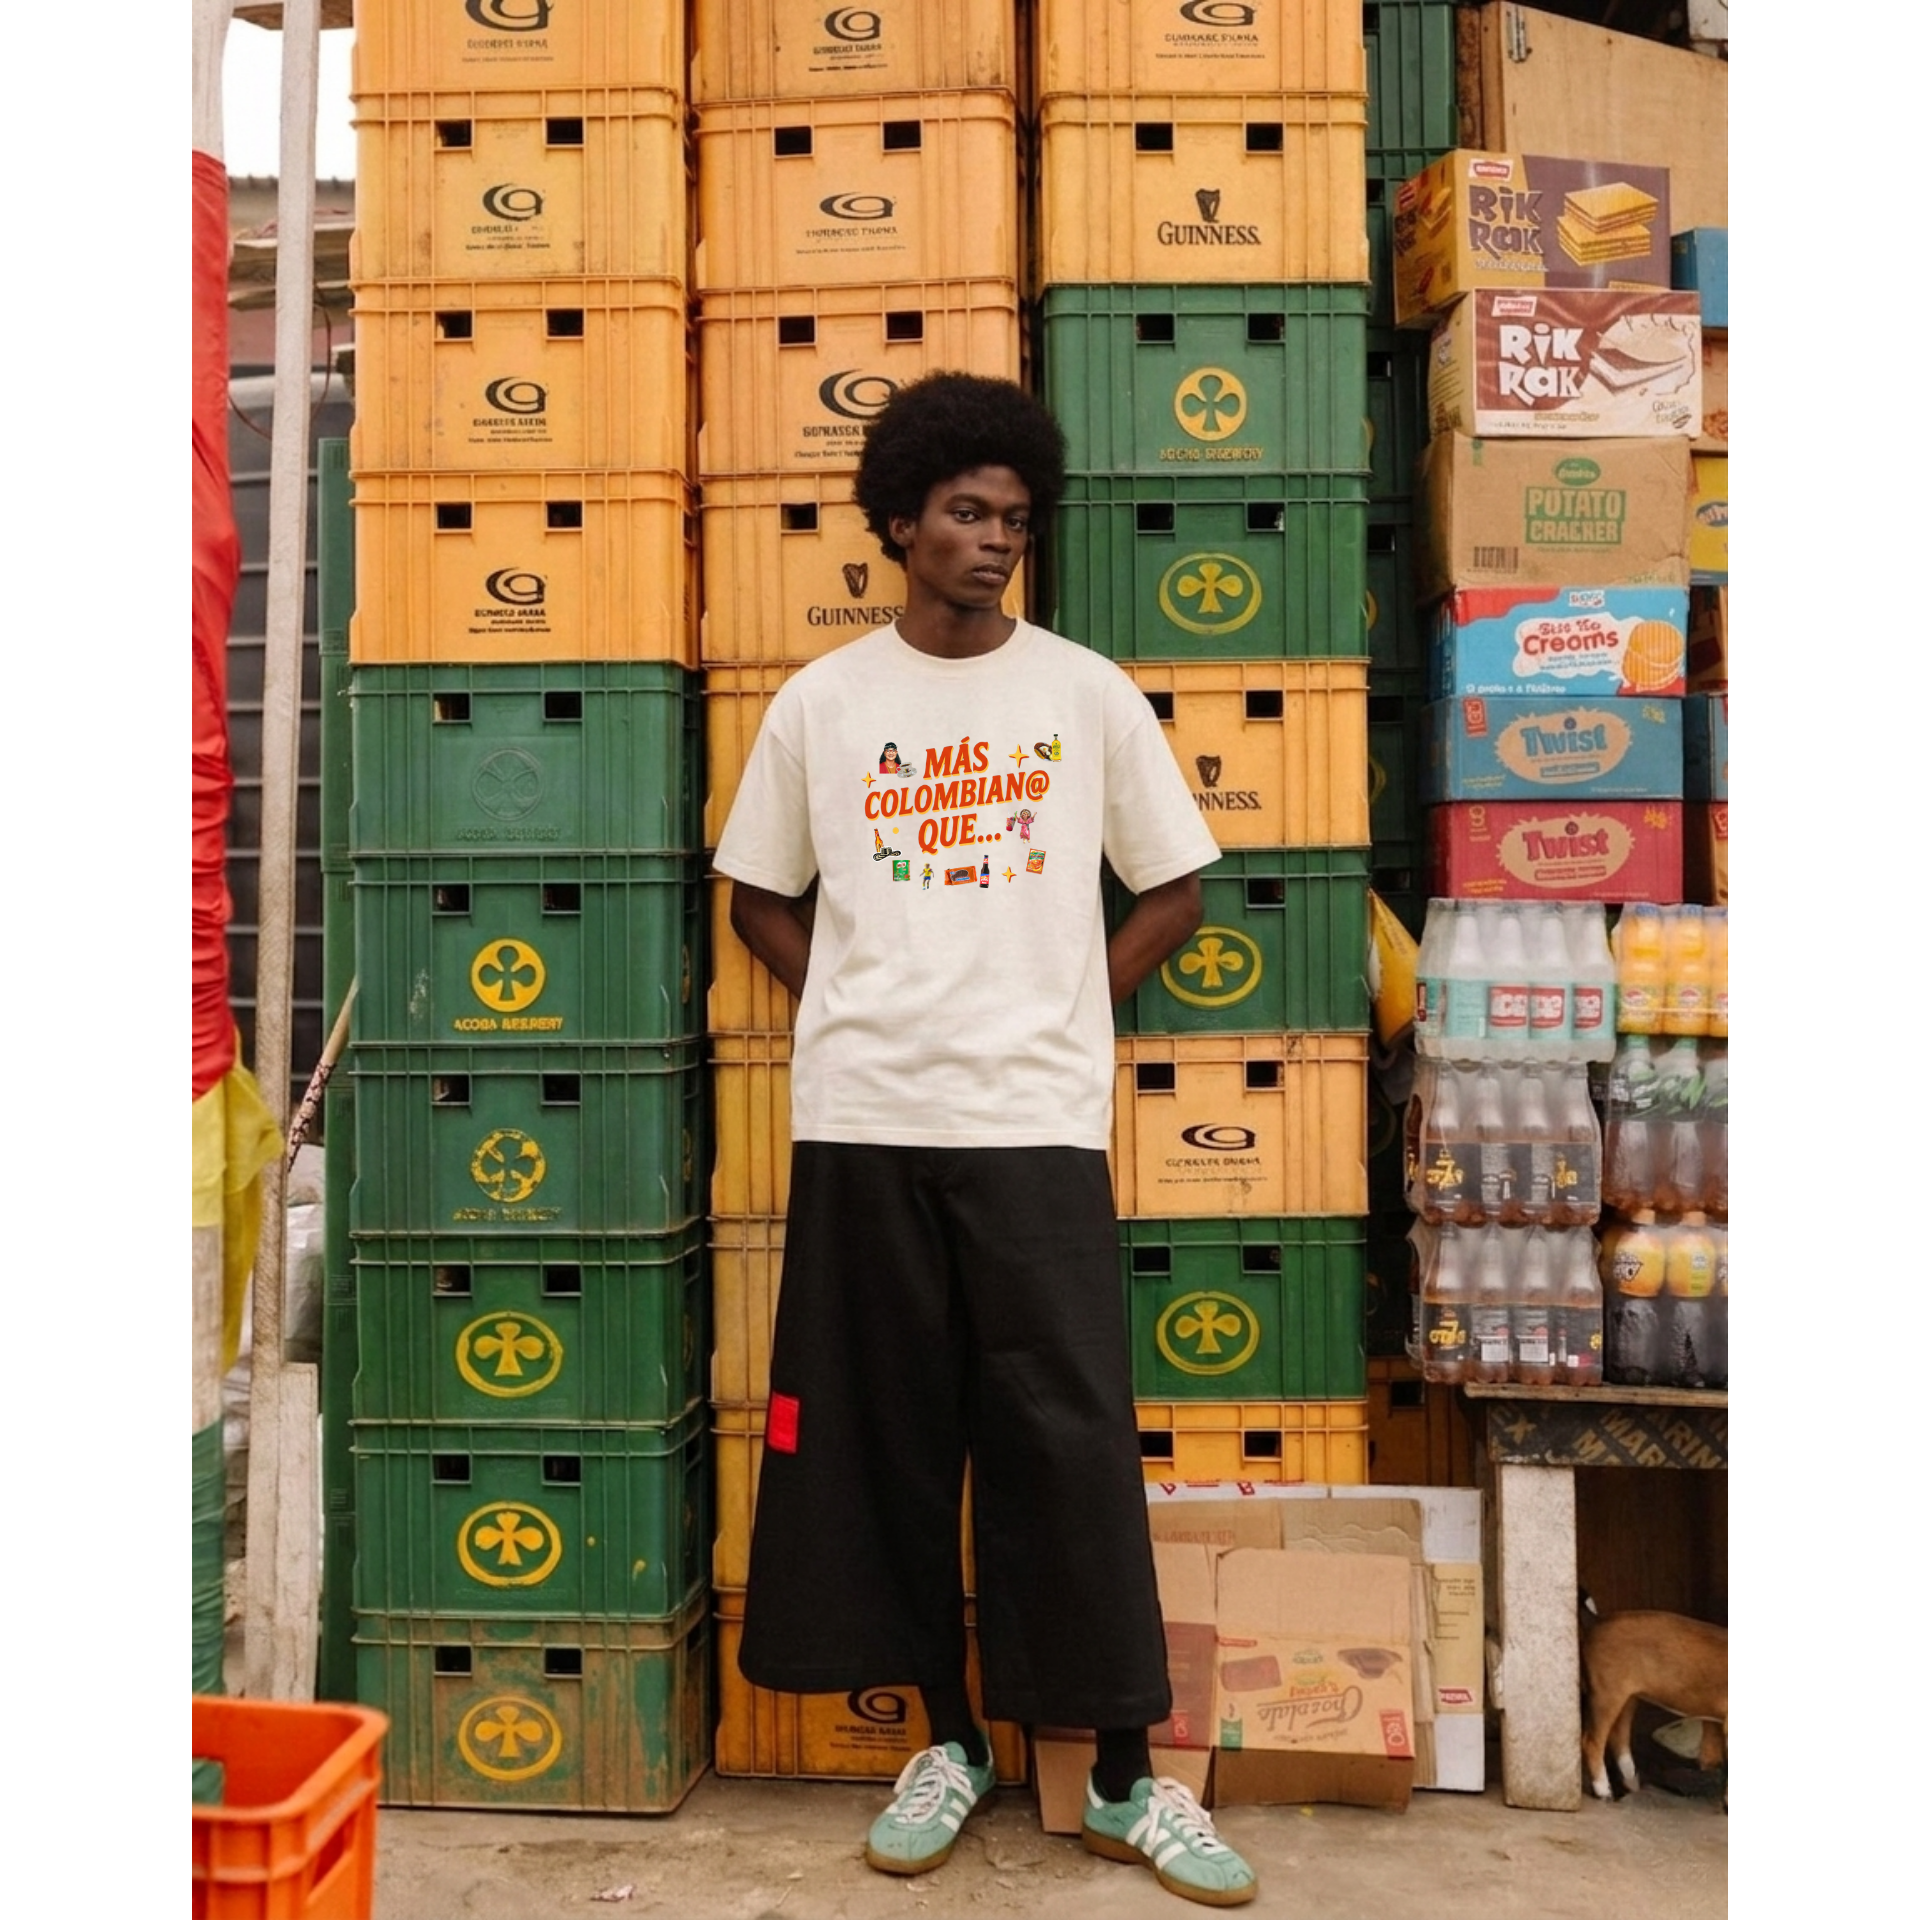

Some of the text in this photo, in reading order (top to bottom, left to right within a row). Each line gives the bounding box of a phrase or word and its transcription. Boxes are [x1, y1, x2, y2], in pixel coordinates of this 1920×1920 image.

[1529, 488, 1621, 519] POTATO
[1520, 717, 1608, 757] Twist
[923, 736, 989, 780] MÁS
[864, 770, 1050, 821] COLOMBIAN@
[918, 813, 1002, 855] QUE...
[1522, 821, 1610, 861] Twist
